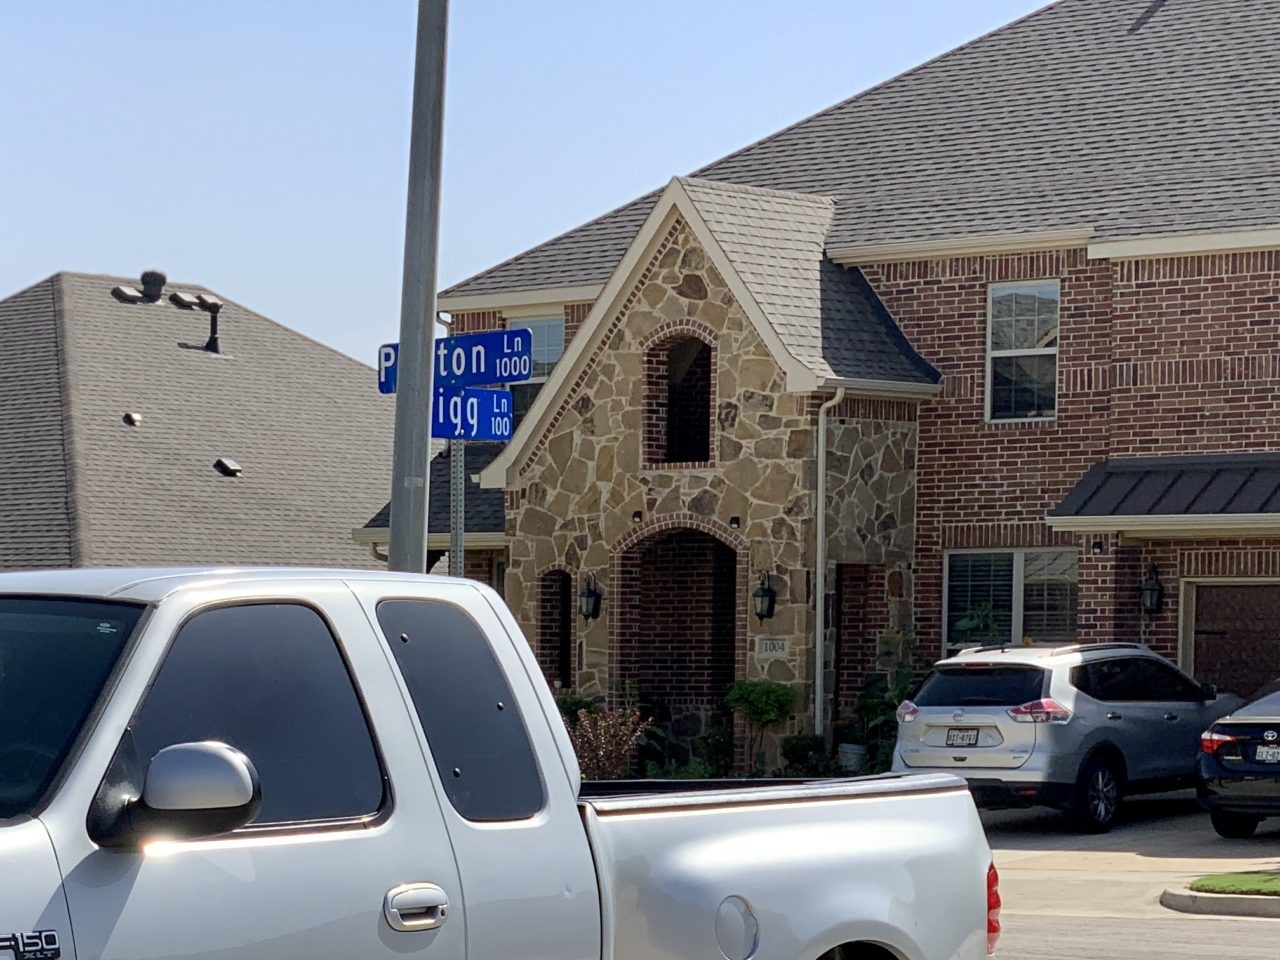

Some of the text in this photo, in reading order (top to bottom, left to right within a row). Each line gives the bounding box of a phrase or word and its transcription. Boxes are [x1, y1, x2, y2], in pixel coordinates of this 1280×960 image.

[503, 334, 522, 353] Ln
[496, 356, 530, 377] 1000
[438, 388, 508, 437] igg Ln
[491, 417, 510, 436] 100
[764, 641, 785, 653] 1004
[24, 951, 56, 959] XLT
